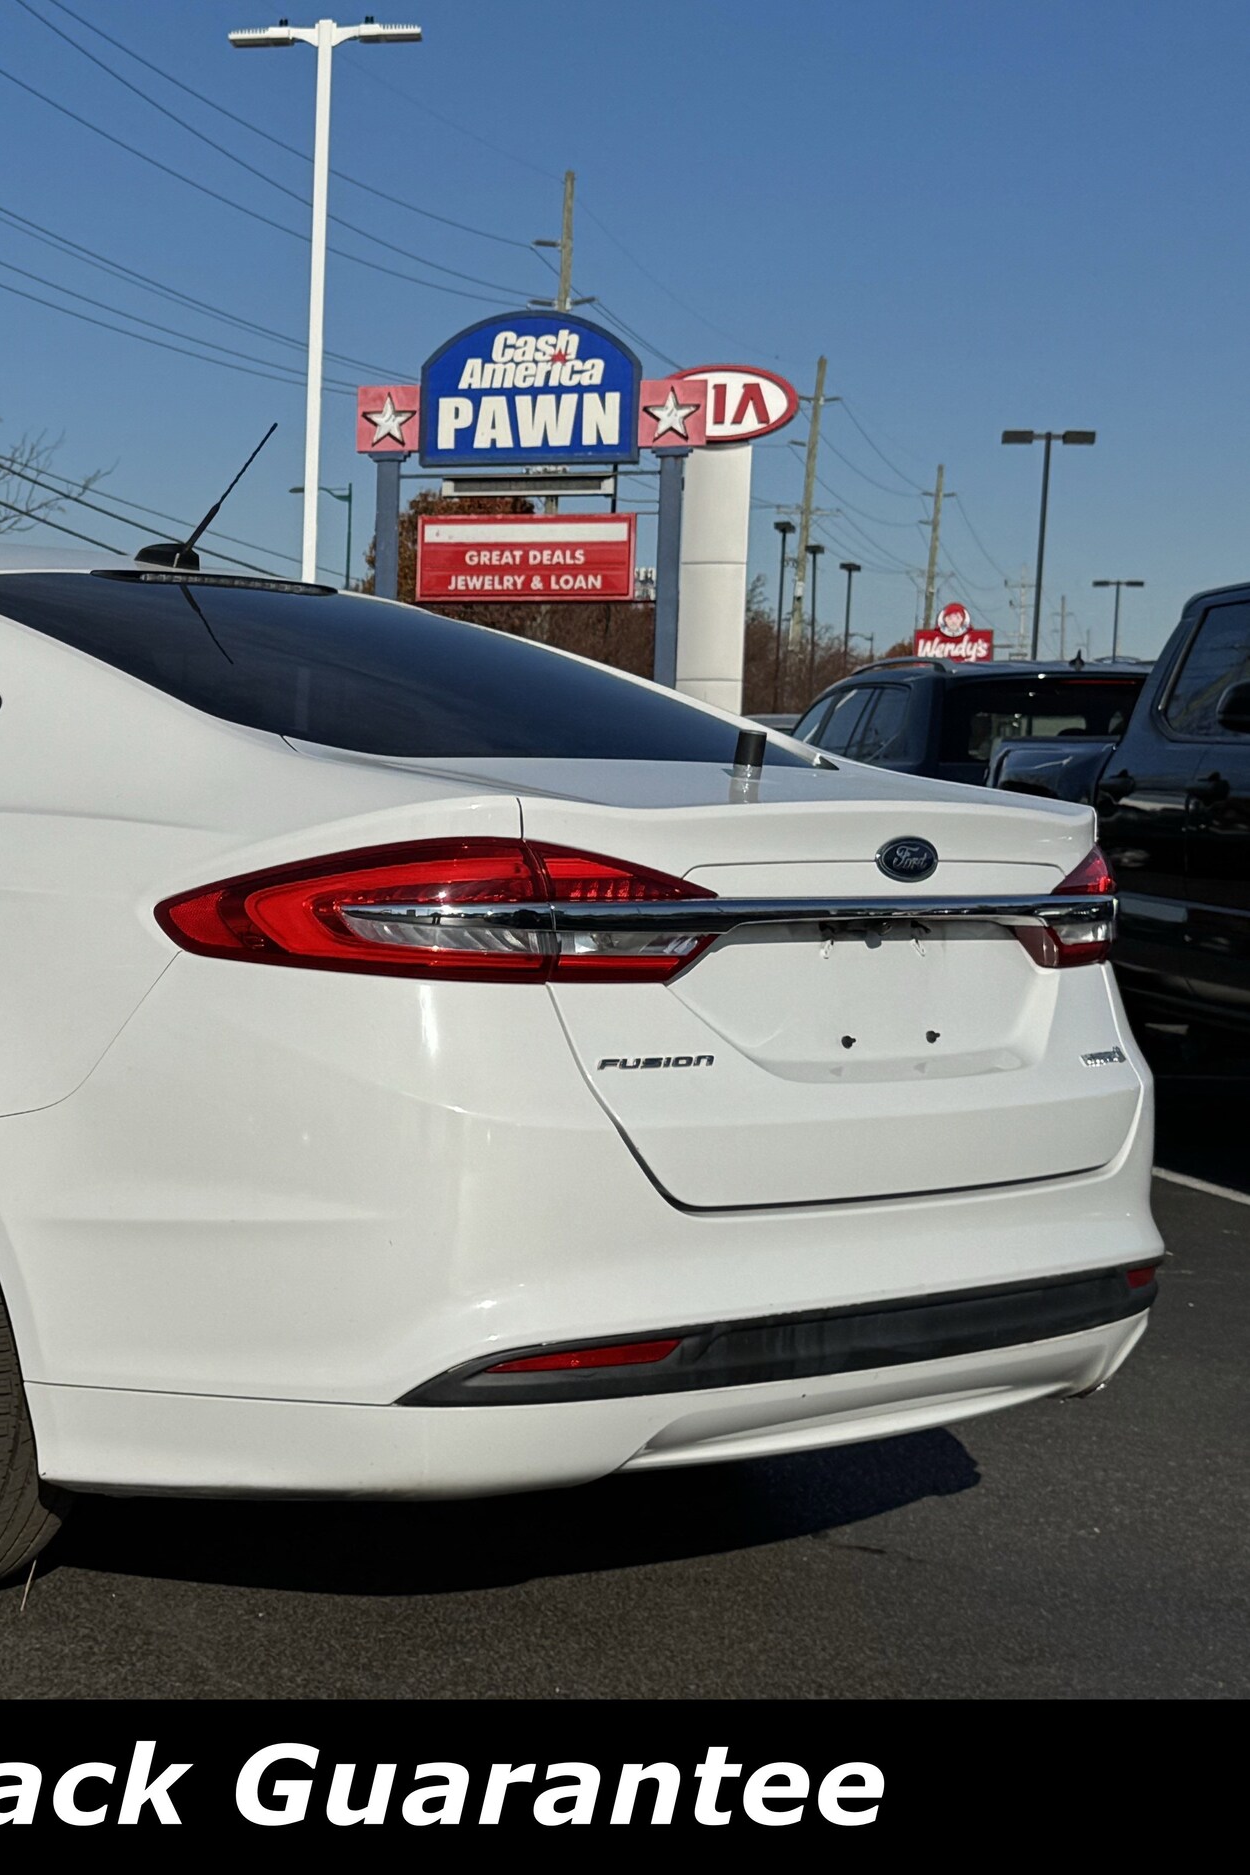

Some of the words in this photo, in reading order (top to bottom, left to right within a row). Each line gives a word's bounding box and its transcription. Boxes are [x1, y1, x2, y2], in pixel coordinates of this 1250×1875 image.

[491, 329, 579, 363] Cash
[457, 357, 605, 390] America
[712, 382, 771, 426] IA
[437, 391, 621, 450] PAWN
[464, 550, 523, 566] GREAT
[528, 549, 585, 565] DEALS
[447, 575, 526, 591] JEWELRY
[530, 575, 544, 590] &
[550, 574, 603, 590] LOAN
[917, 634, 989, 662] Wendy's
[892, 845, 928, 870] Ford
[597, 1055, 714, 1071] FUSION
